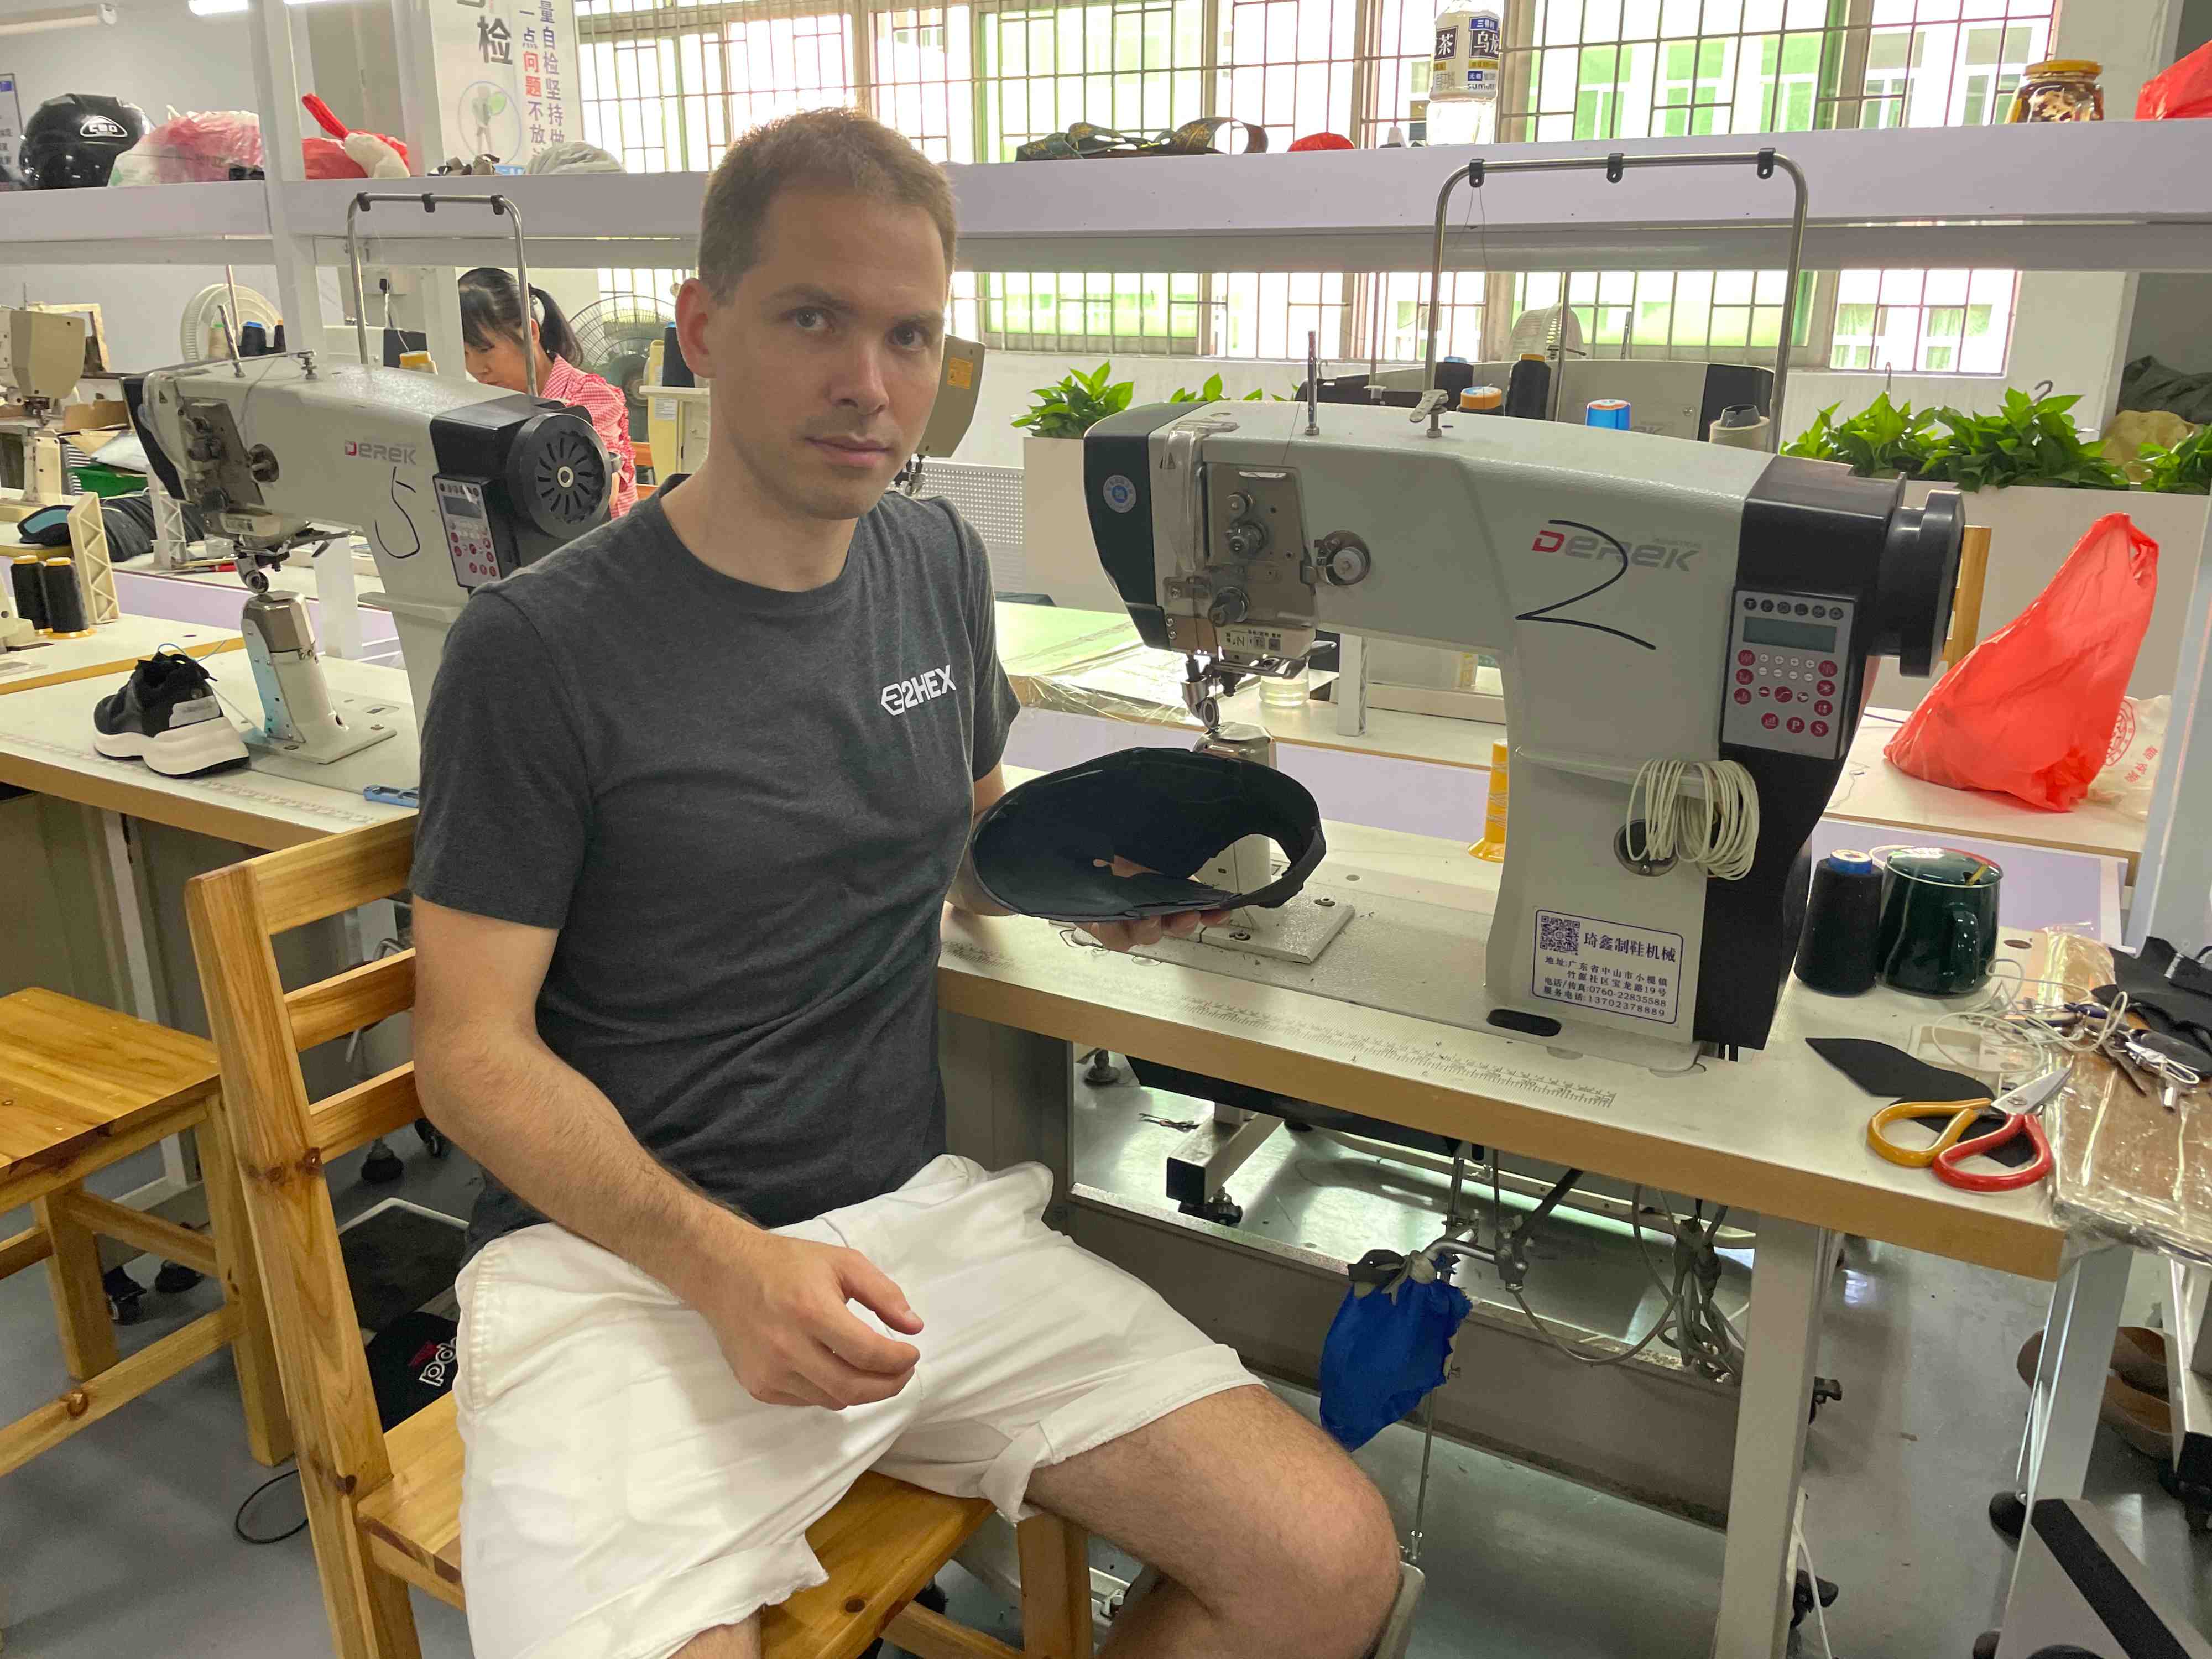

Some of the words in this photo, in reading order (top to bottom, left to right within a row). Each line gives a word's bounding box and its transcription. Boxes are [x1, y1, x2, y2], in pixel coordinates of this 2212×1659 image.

[374, 466, 420, 559] 5
[1515, 520, 1656, 650] 2
[1584, 932, 1676, 962] 琦鑫制鞋机械
